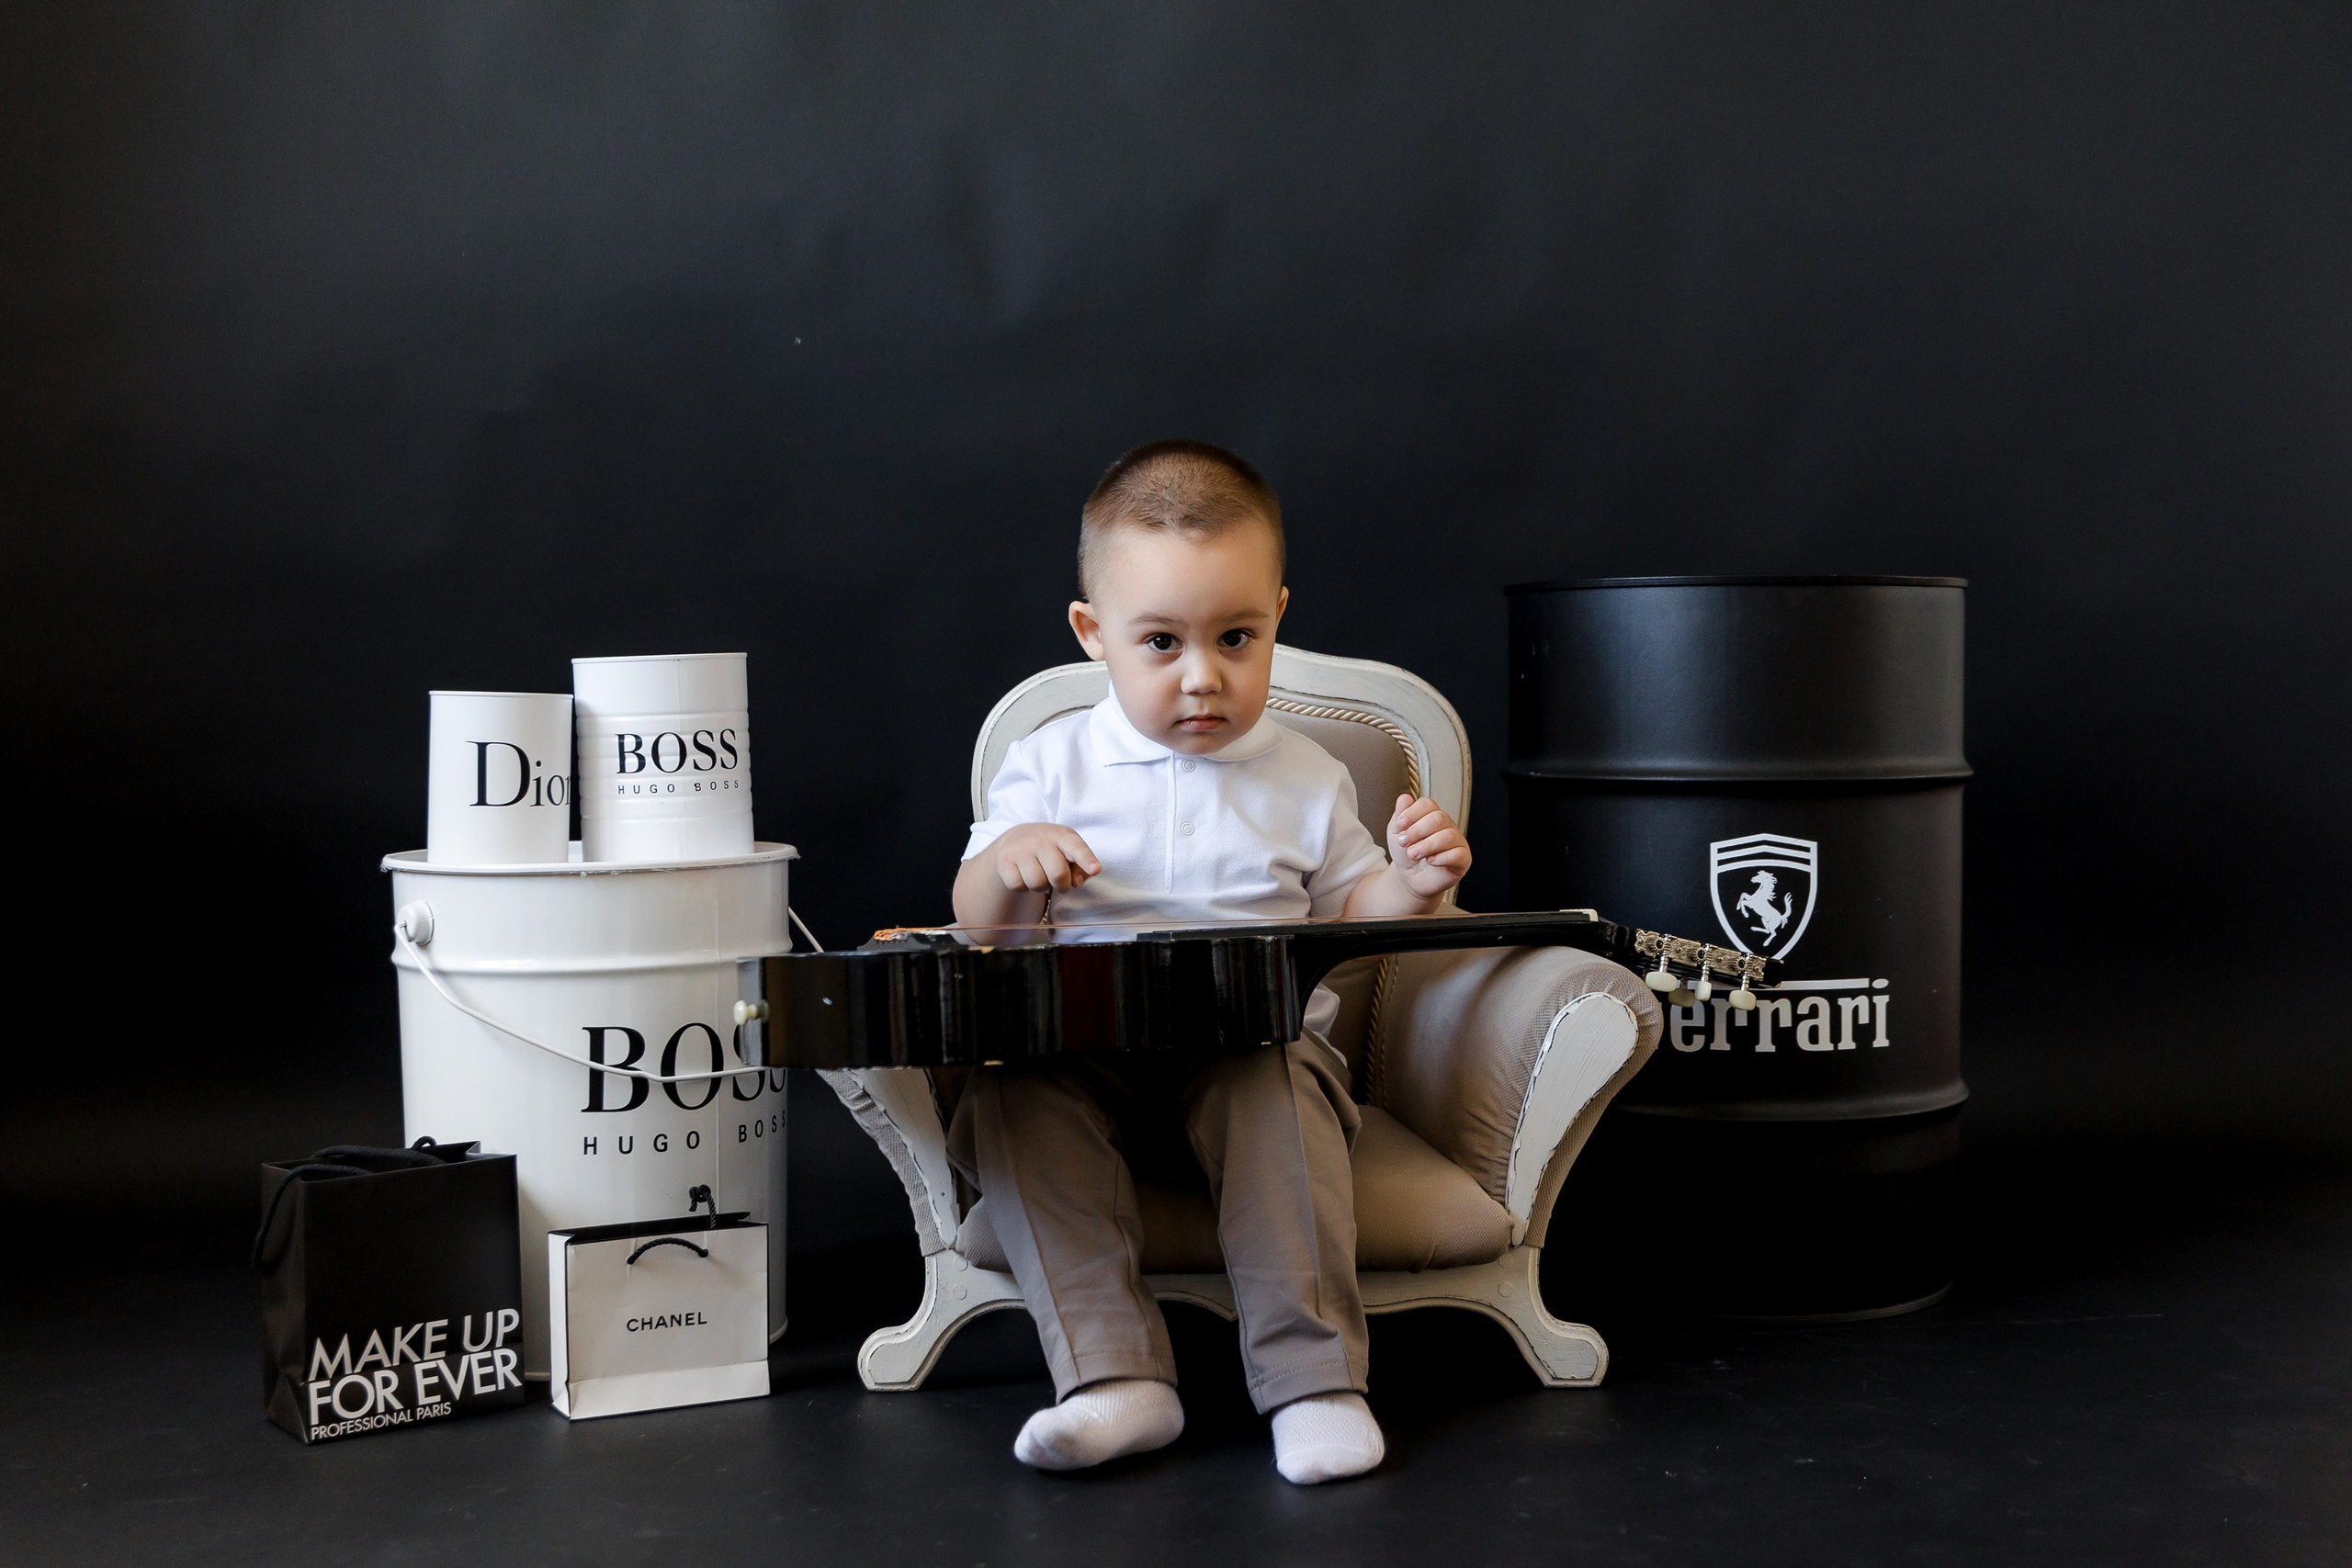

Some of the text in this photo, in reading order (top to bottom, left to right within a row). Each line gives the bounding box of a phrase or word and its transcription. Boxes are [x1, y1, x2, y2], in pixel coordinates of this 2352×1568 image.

[615, 728, 738, 774] BOSS
[617, 780, 739, 795] HUGO BOSS
[1658, 977, 1891, 1054] errari
[583, 1110, 786, 1156] HUGO BOSS
[308, 1308, 520, 1381] MAKE UP
[626, 1311, 707, 1332] CHANEL
[308, 1348, 523, 1426] FOR EVER
[311, 1402, 452, 1441] PROFESSIONAL PARIS
